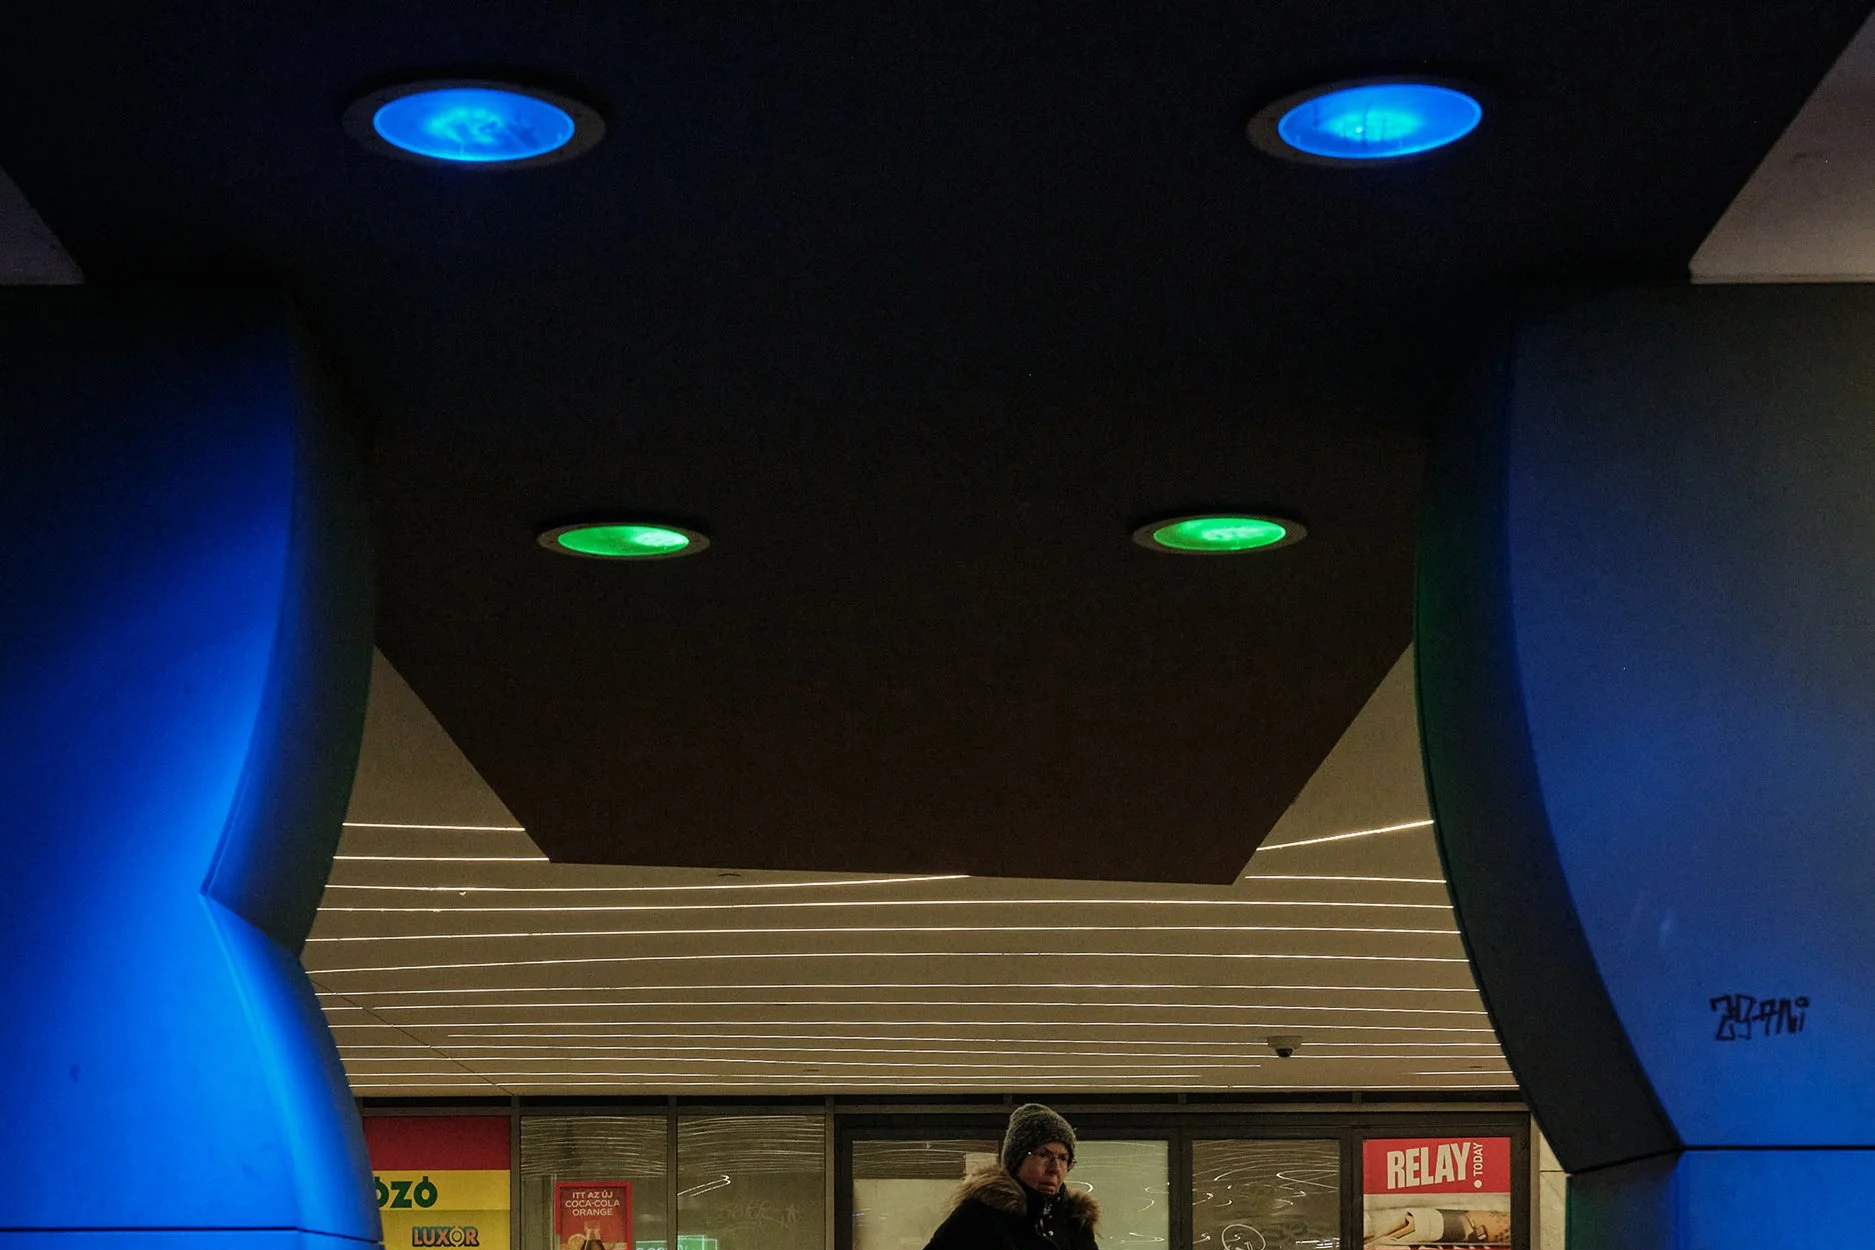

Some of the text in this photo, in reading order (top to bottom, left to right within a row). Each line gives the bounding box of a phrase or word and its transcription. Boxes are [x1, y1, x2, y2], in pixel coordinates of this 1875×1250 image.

[1387, 1142, 1471, 1190] RELAY
[1473, 1142, 1484, 1177] TODAY
[572, 1189, 613, 1199] ITT AZ ÚJ
[565, 1199, 621, 1208] COCA-COLA
[572, 1208, 614, 1216] ORANGE
[412, 1226, 480, 1247] LUXOR
